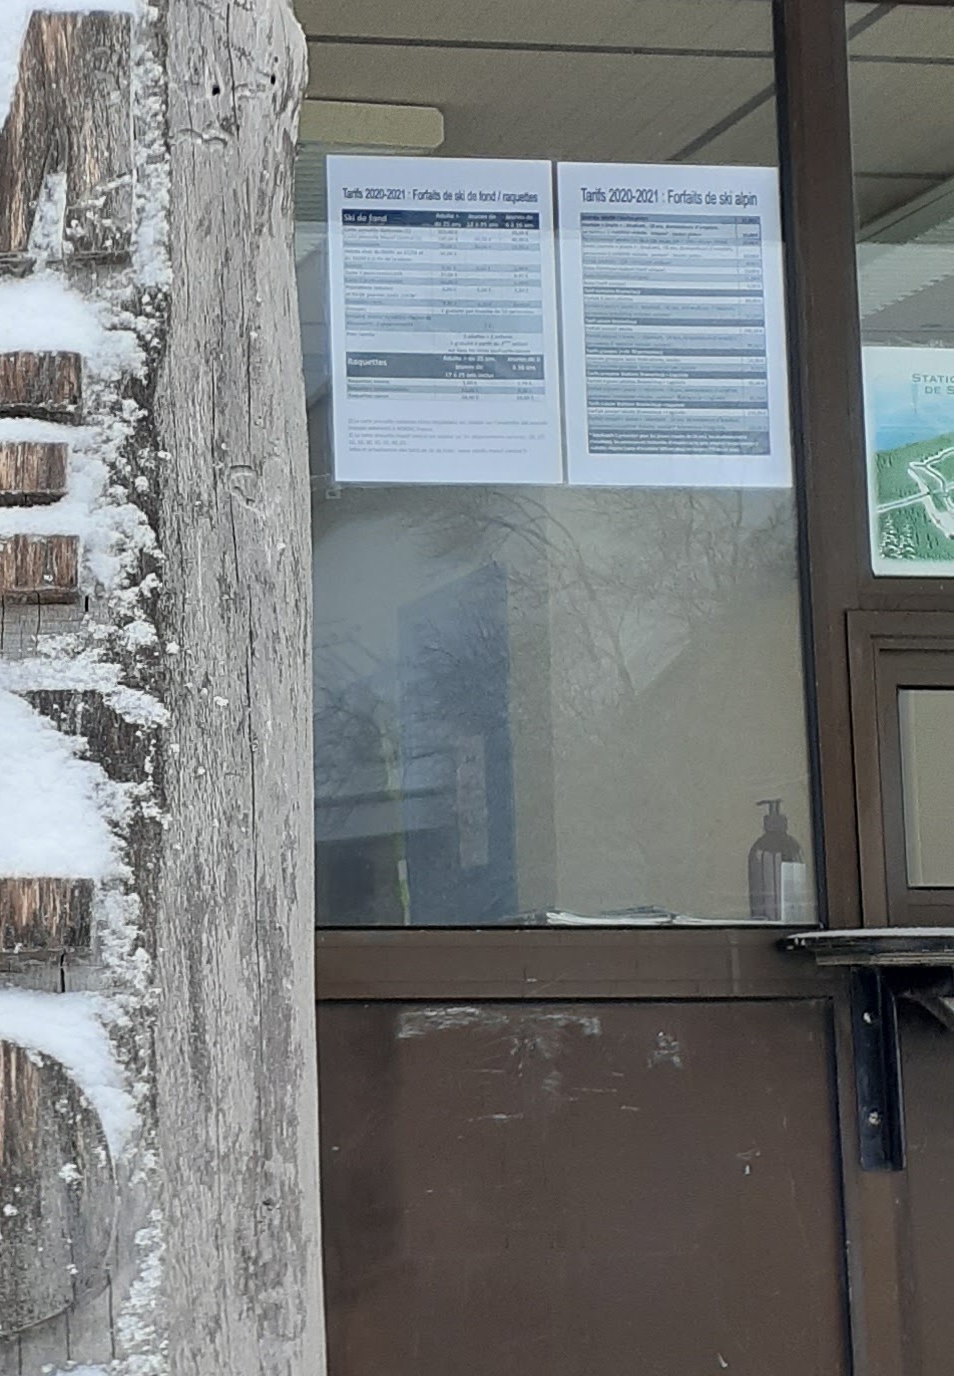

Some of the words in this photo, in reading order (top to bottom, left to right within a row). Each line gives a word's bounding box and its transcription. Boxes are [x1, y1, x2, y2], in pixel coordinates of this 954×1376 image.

[342, 187, 363, 199] Tarifs
[365, 188, 406, 200] 2020-2021
[412, 189, 441, 201] Forfaits
[443, 190, 452, 201] de
[454, 190, 466, 201] ski
[467, 191, 477, 202] de
[479, 191, 496, 202] fond
[502, 191, 538, 204] raquettes
[580, 187, 606, 202] Tarifs
[608, 188, 659, 203] 2020-2021
[667, 189, 703, 204] Forfaits
[704, 191, 717, 205] de
[719, 190, 733, 205] ski
[735, 191, 758, 208] alpin
[343, 213, 355, 222] Ski
[356, 213, 367, 222] de
[347, 357, 388, 367] Raquettes
